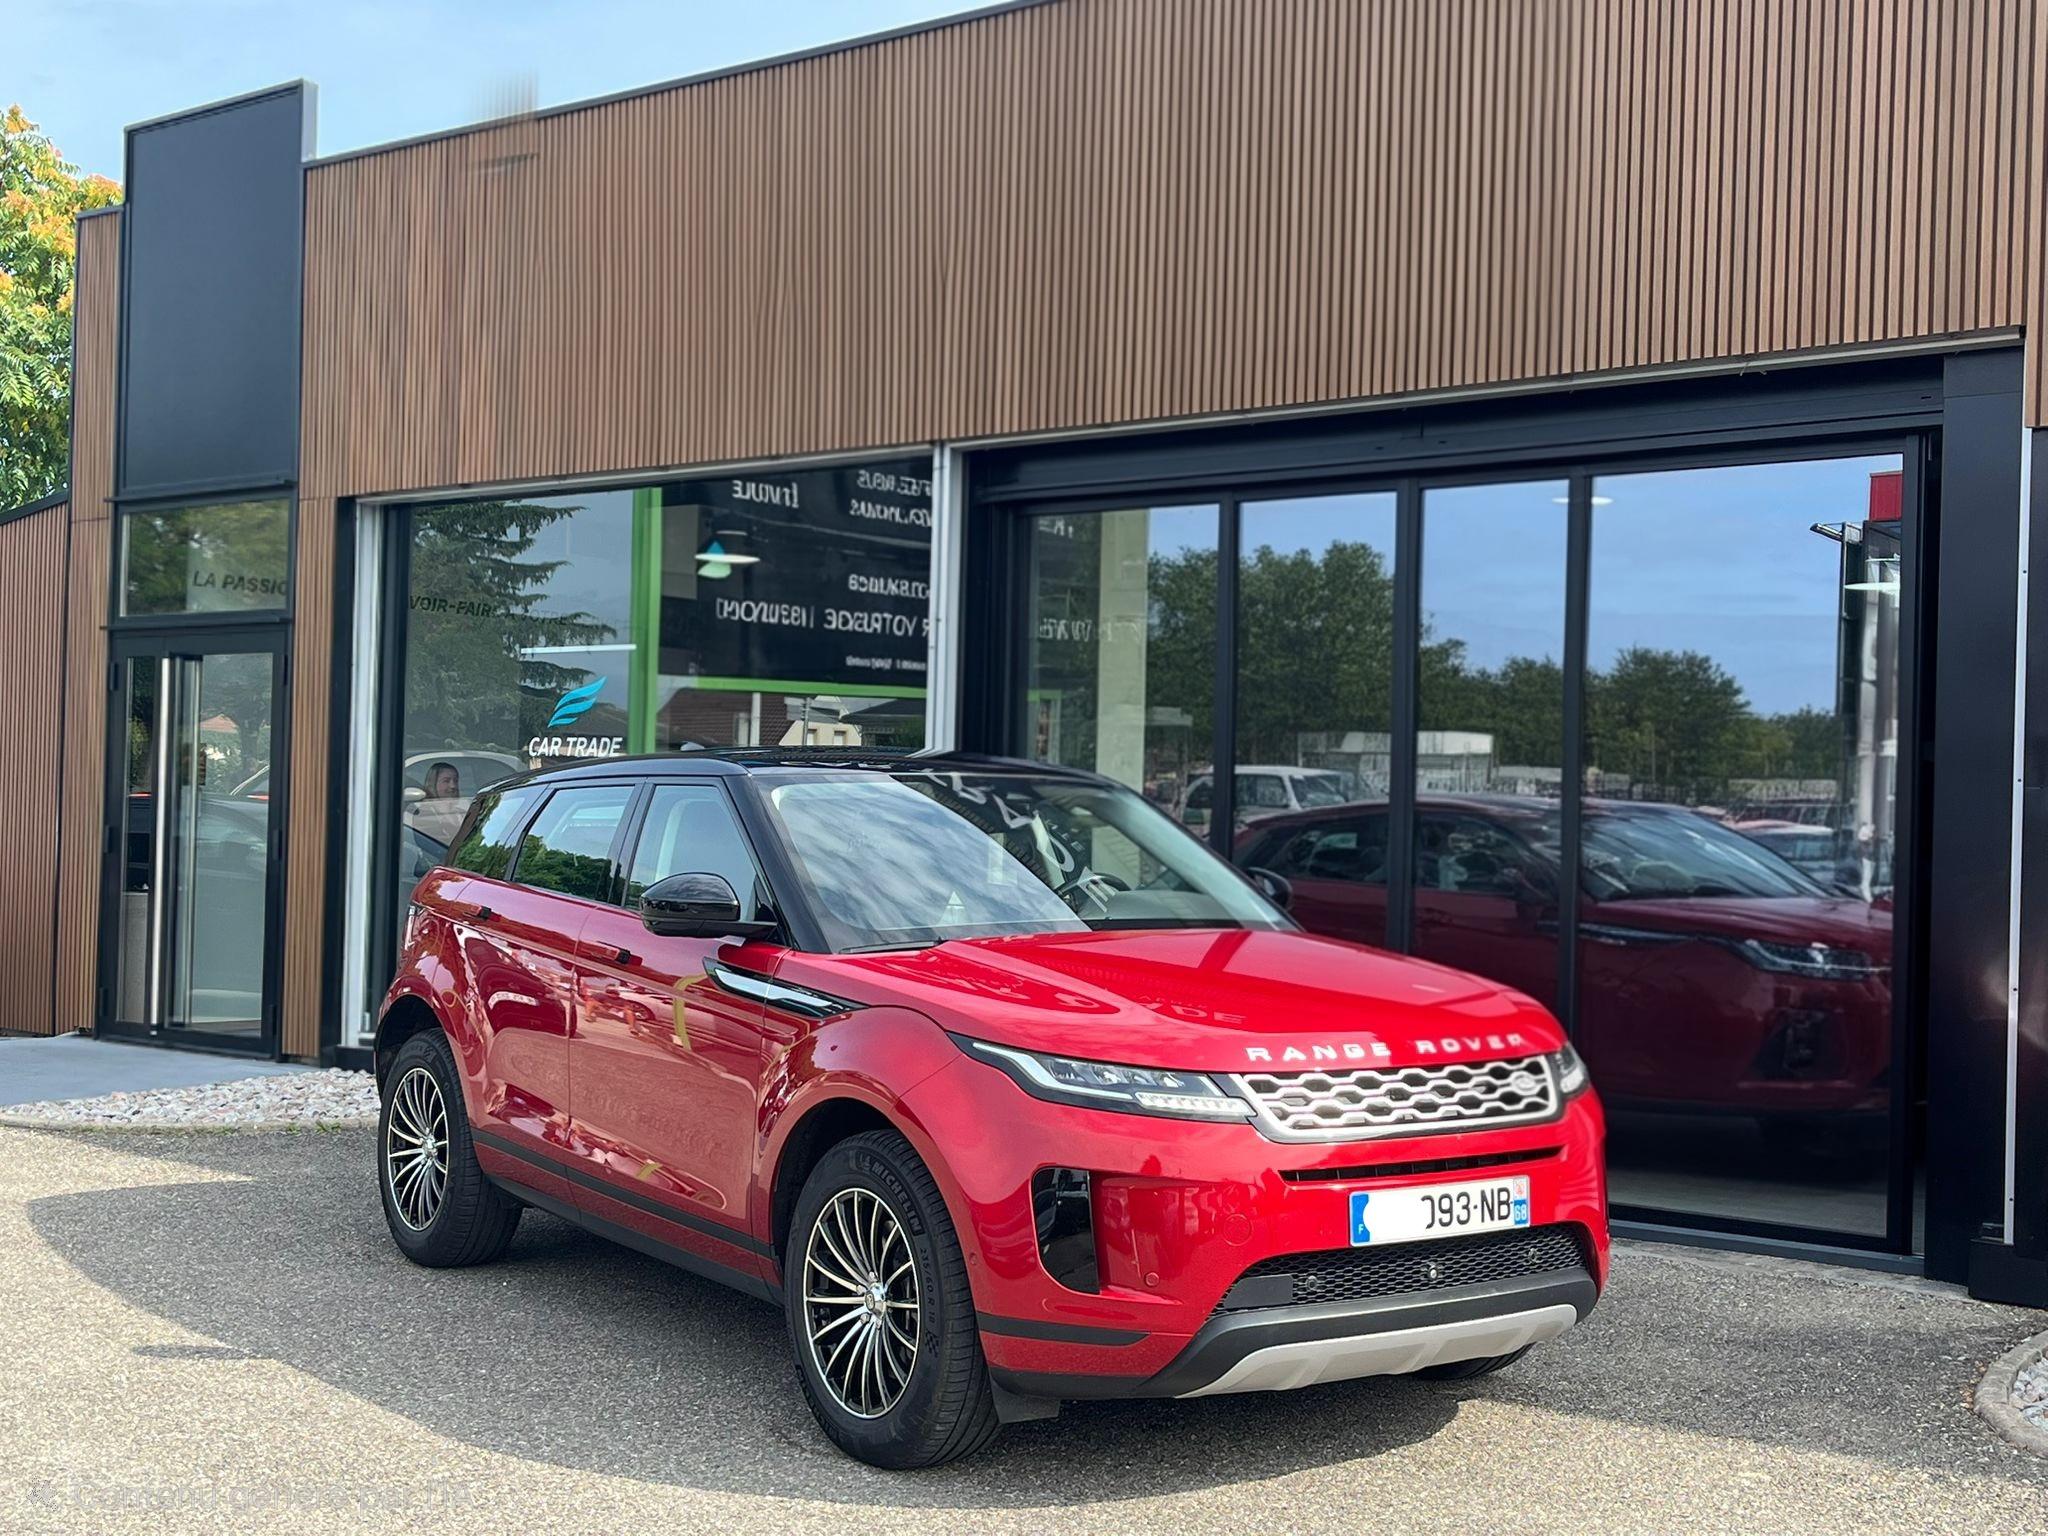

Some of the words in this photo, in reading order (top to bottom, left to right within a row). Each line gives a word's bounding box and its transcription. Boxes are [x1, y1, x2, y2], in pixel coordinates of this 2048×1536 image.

[192, 570, 216, 589] LA
[528, 736, 562, 757] CAR
[565, 736, 623, 757] TRADE
[1245, 1042, 1391, 1062] RANGE
[1415, 1033, 1526, 1055] ROVER
[871, 1161, 922, 1232] MICHELIN
[1514, 1204, 1527, 1221] 68
[1358, 1223, 1364, 1235] F
